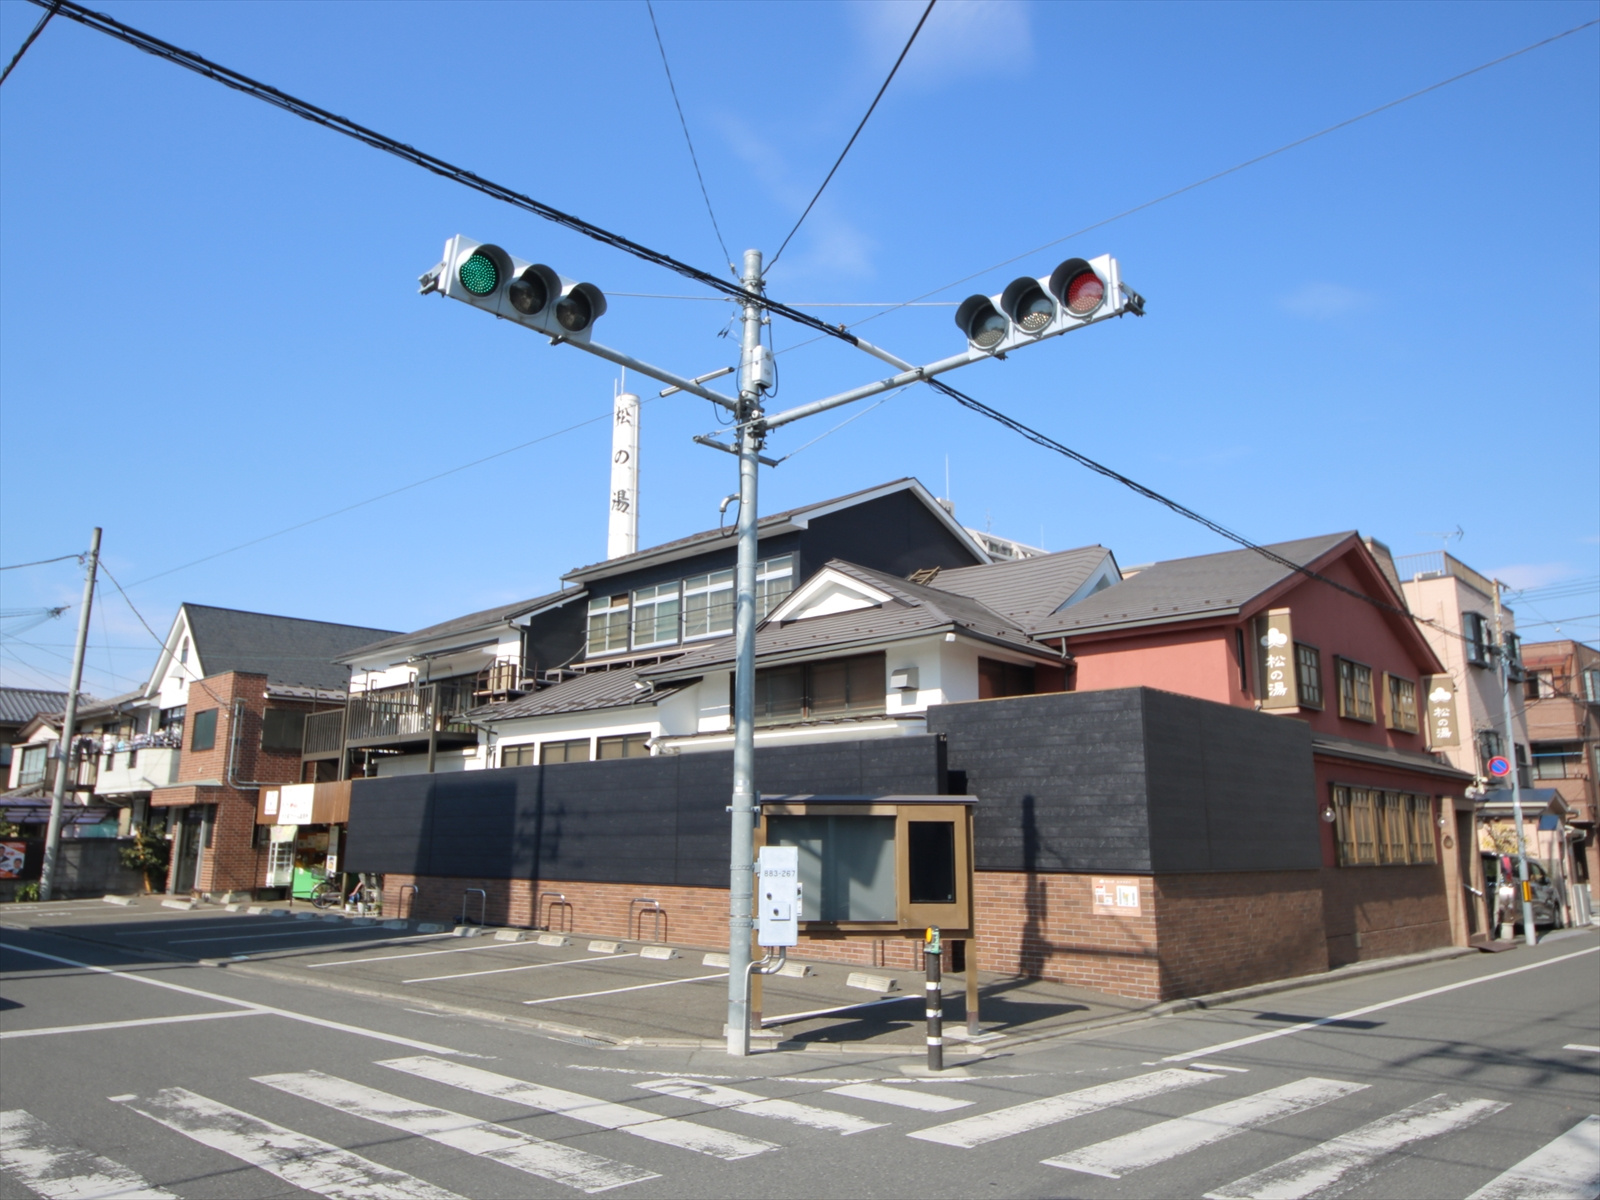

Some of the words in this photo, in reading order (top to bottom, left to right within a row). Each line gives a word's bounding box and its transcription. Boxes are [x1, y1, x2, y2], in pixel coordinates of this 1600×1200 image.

[612, 406, 632, 514] 松の湯
[1265, 654, 1288, 697] 松の湯
[1433, 706, 1453, 739] 松の湯
[764, 869, 796, 878] 883-267
